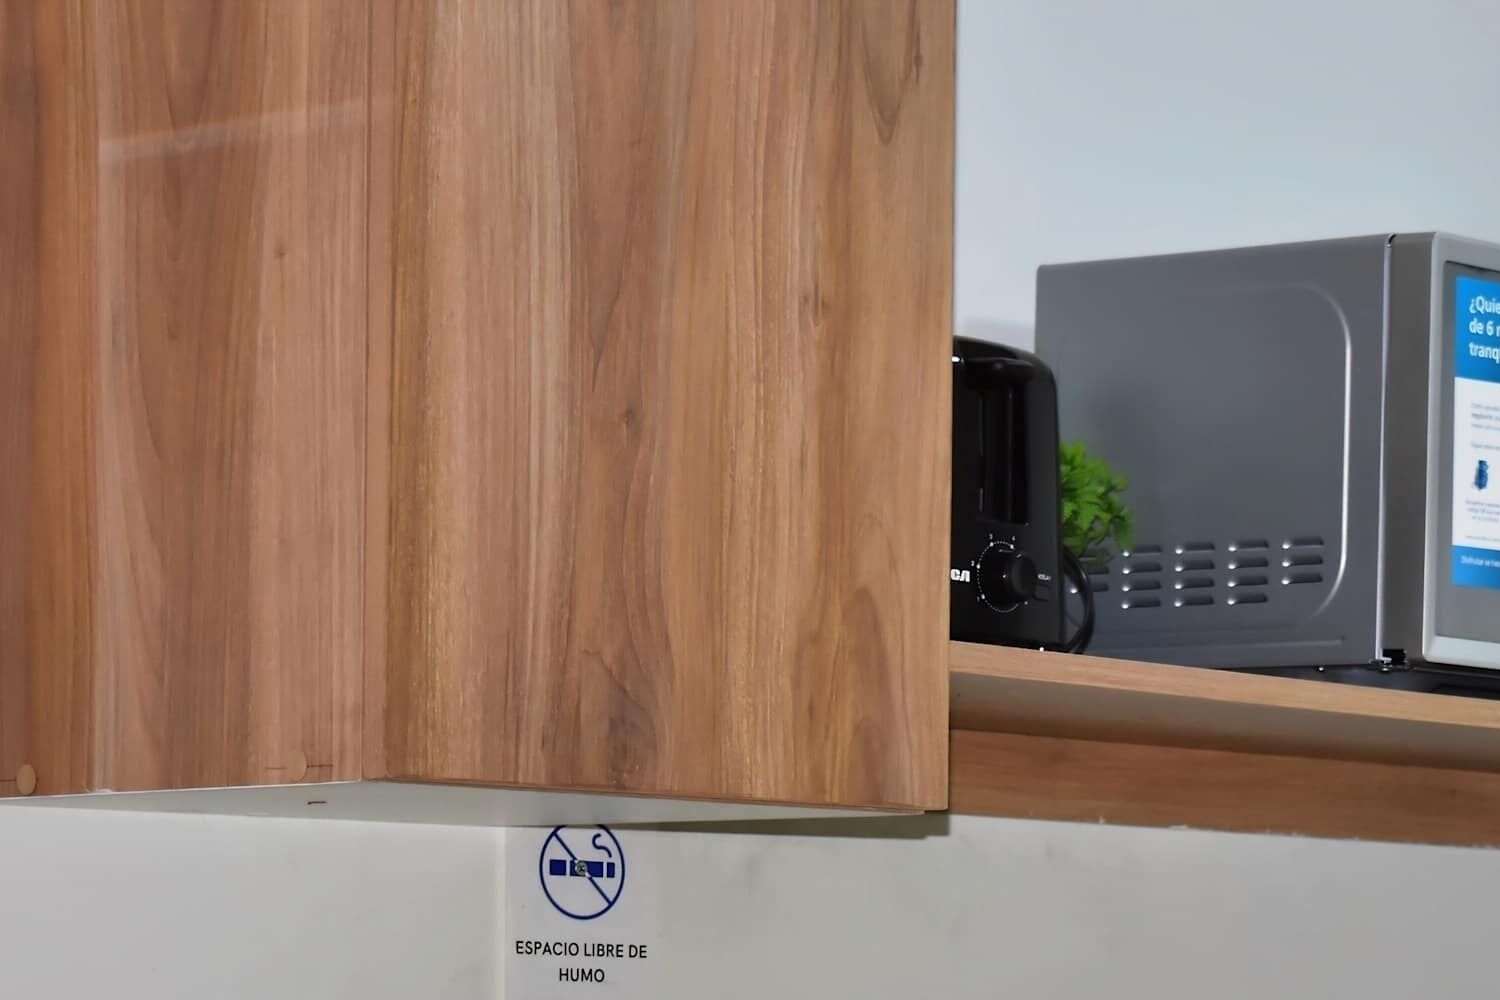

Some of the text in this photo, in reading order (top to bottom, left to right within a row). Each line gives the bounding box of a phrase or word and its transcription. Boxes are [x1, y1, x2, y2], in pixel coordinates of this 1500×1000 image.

[1469, 318, 1483, 334] de
[1486, 321, 1494, 337] 6
[515, 940, 648, 958] ESPACIO LIBRE DE
[559, 968, 605, 983] HUMO
